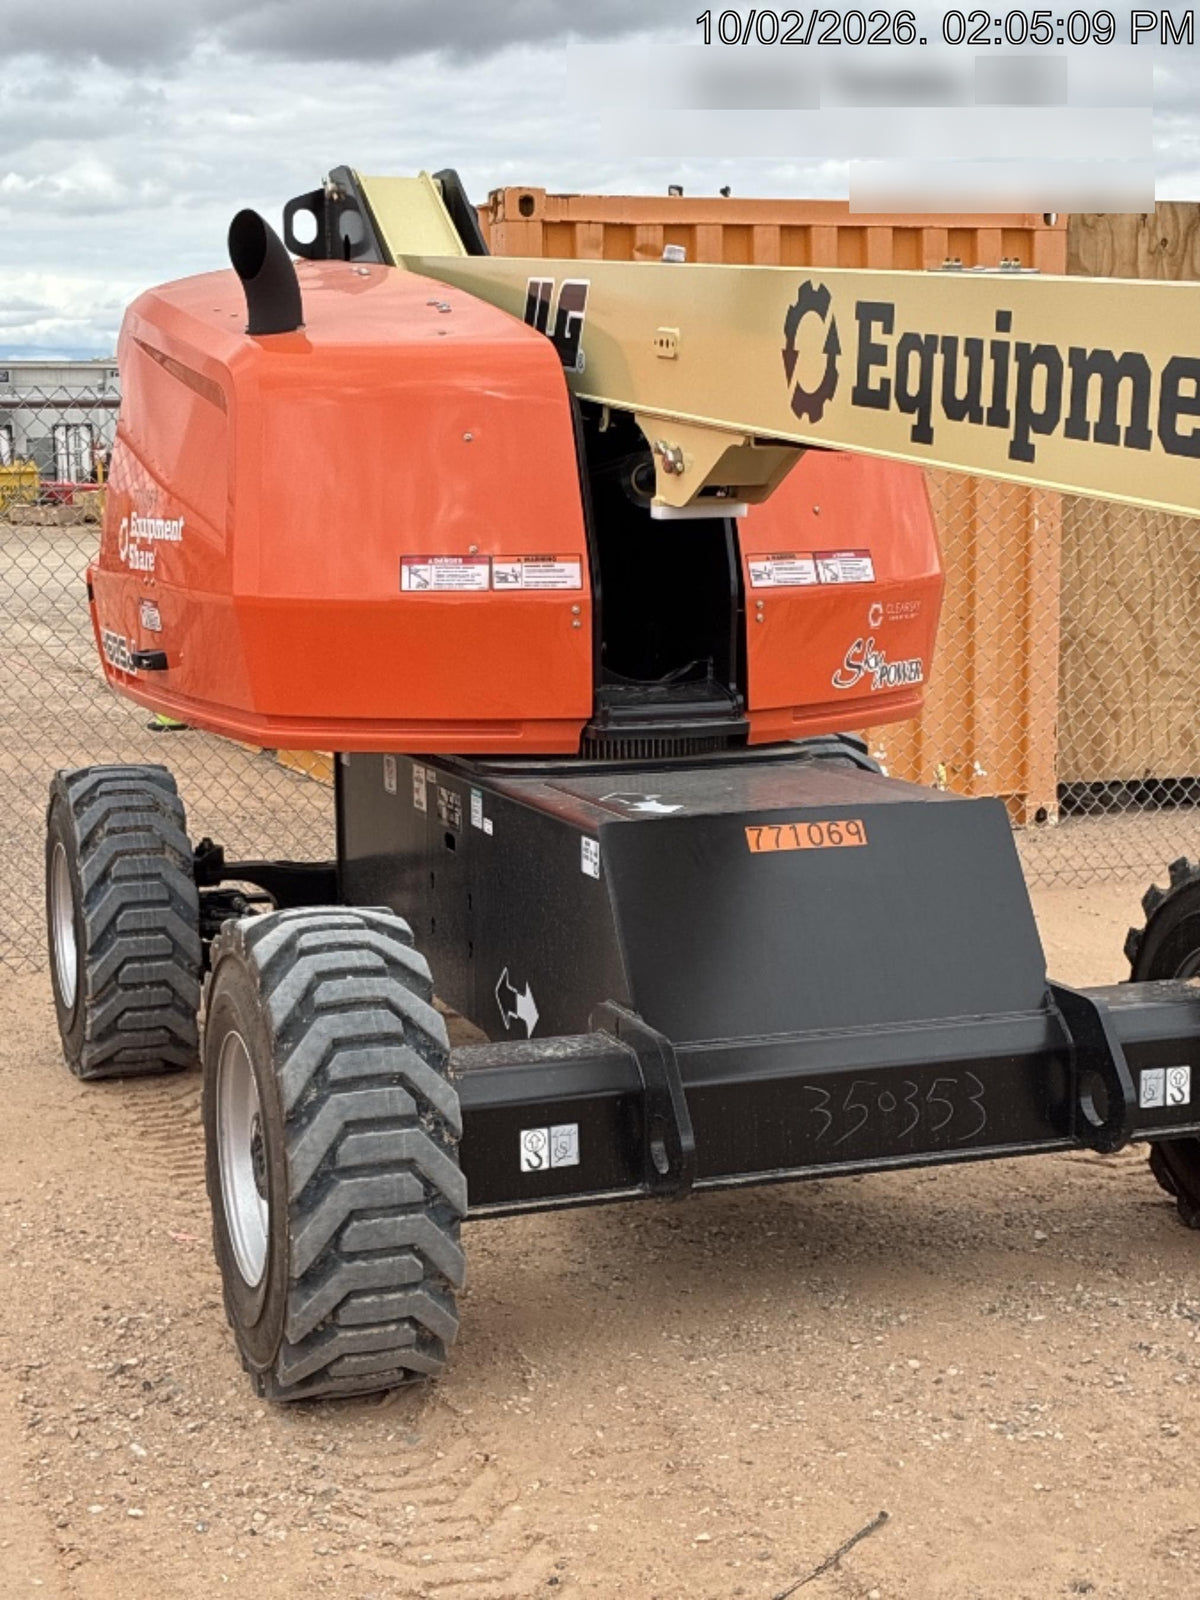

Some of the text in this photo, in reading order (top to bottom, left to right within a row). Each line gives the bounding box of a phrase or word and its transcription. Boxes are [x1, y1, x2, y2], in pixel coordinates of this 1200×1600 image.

[130, 512, 184, 545] Equipment
[129, 543, 155, 571] Share
[832, 636, 886, 691] Sky
[877, 657, 923, 689] POWER
[747, 820, 863, 850] 771069
[803, 1071, 987, 1146] 350353
